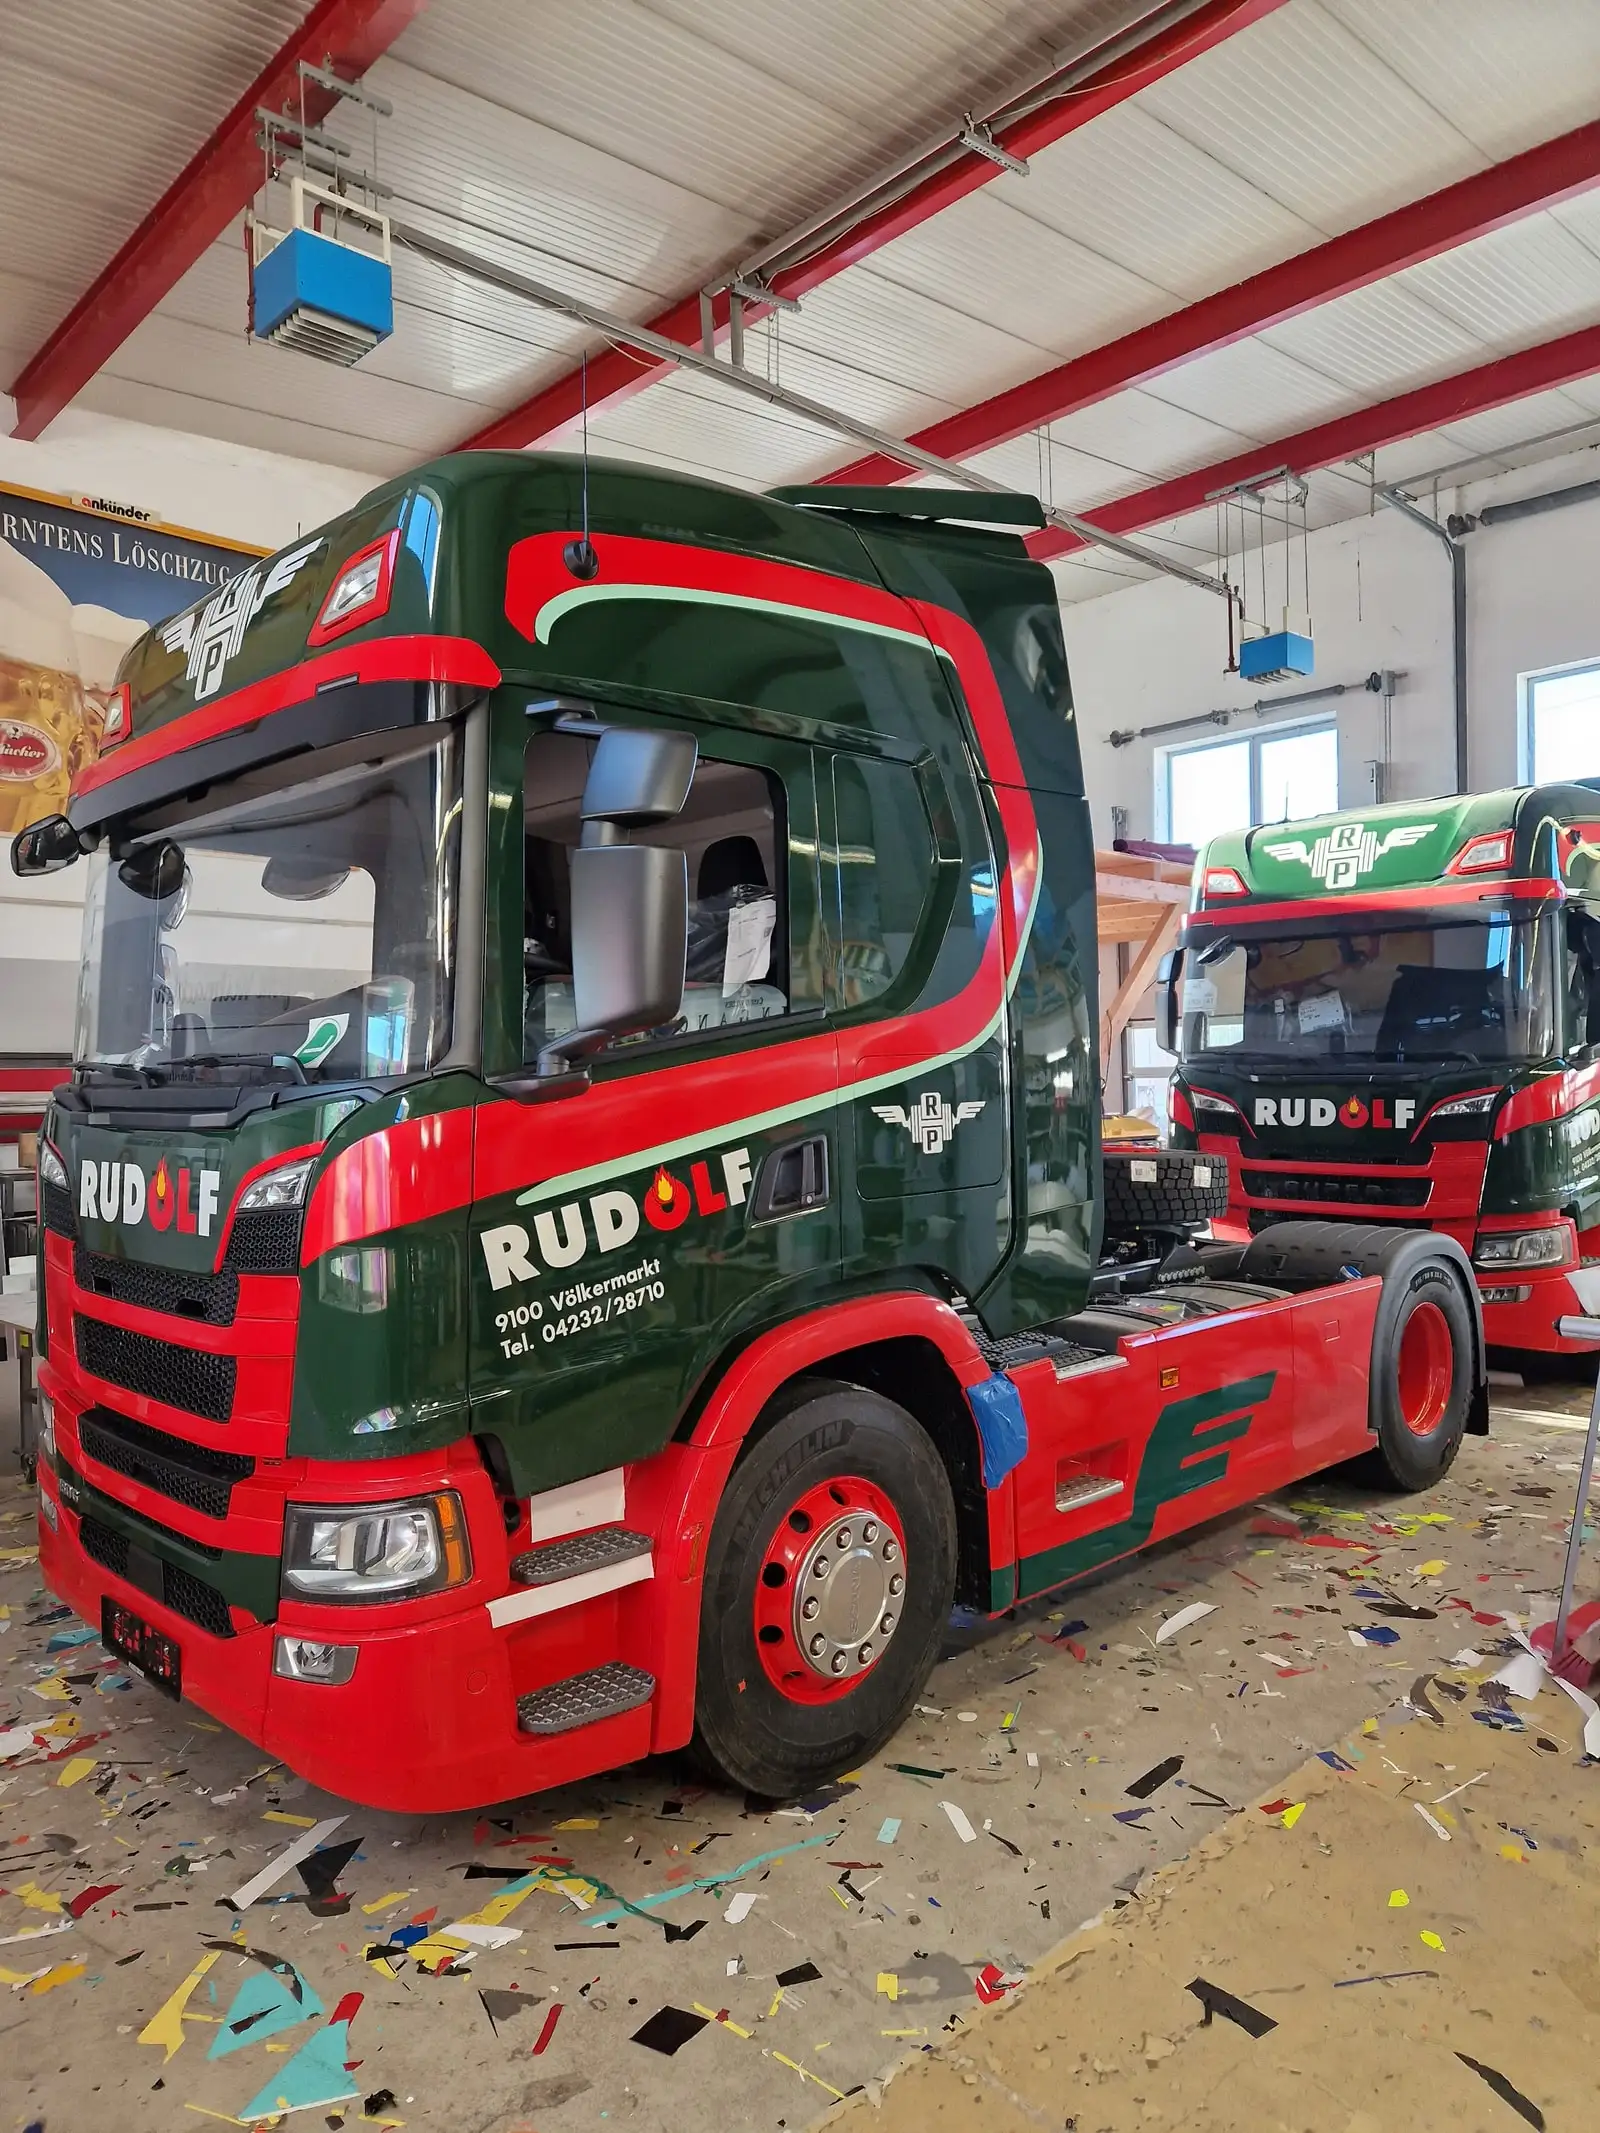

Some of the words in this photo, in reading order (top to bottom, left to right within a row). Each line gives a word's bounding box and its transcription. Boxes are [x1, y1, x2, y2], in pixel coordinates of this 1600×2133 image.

[81, 495, 151, 522] ankünder
[1255, 1096, 1415, 1129] RUDOLF
[79, 1156, 220, 1237] RUDOLF
[480, 1148, 752, 1291] RUDOLF
[494, 1301, 543, 1333] 9100
[549, 1258, 661, 1312] Völkermarkt
[500, 1333, 535, 1359] Tel.
[542, 1281, 665, 1344] 04232/28710
